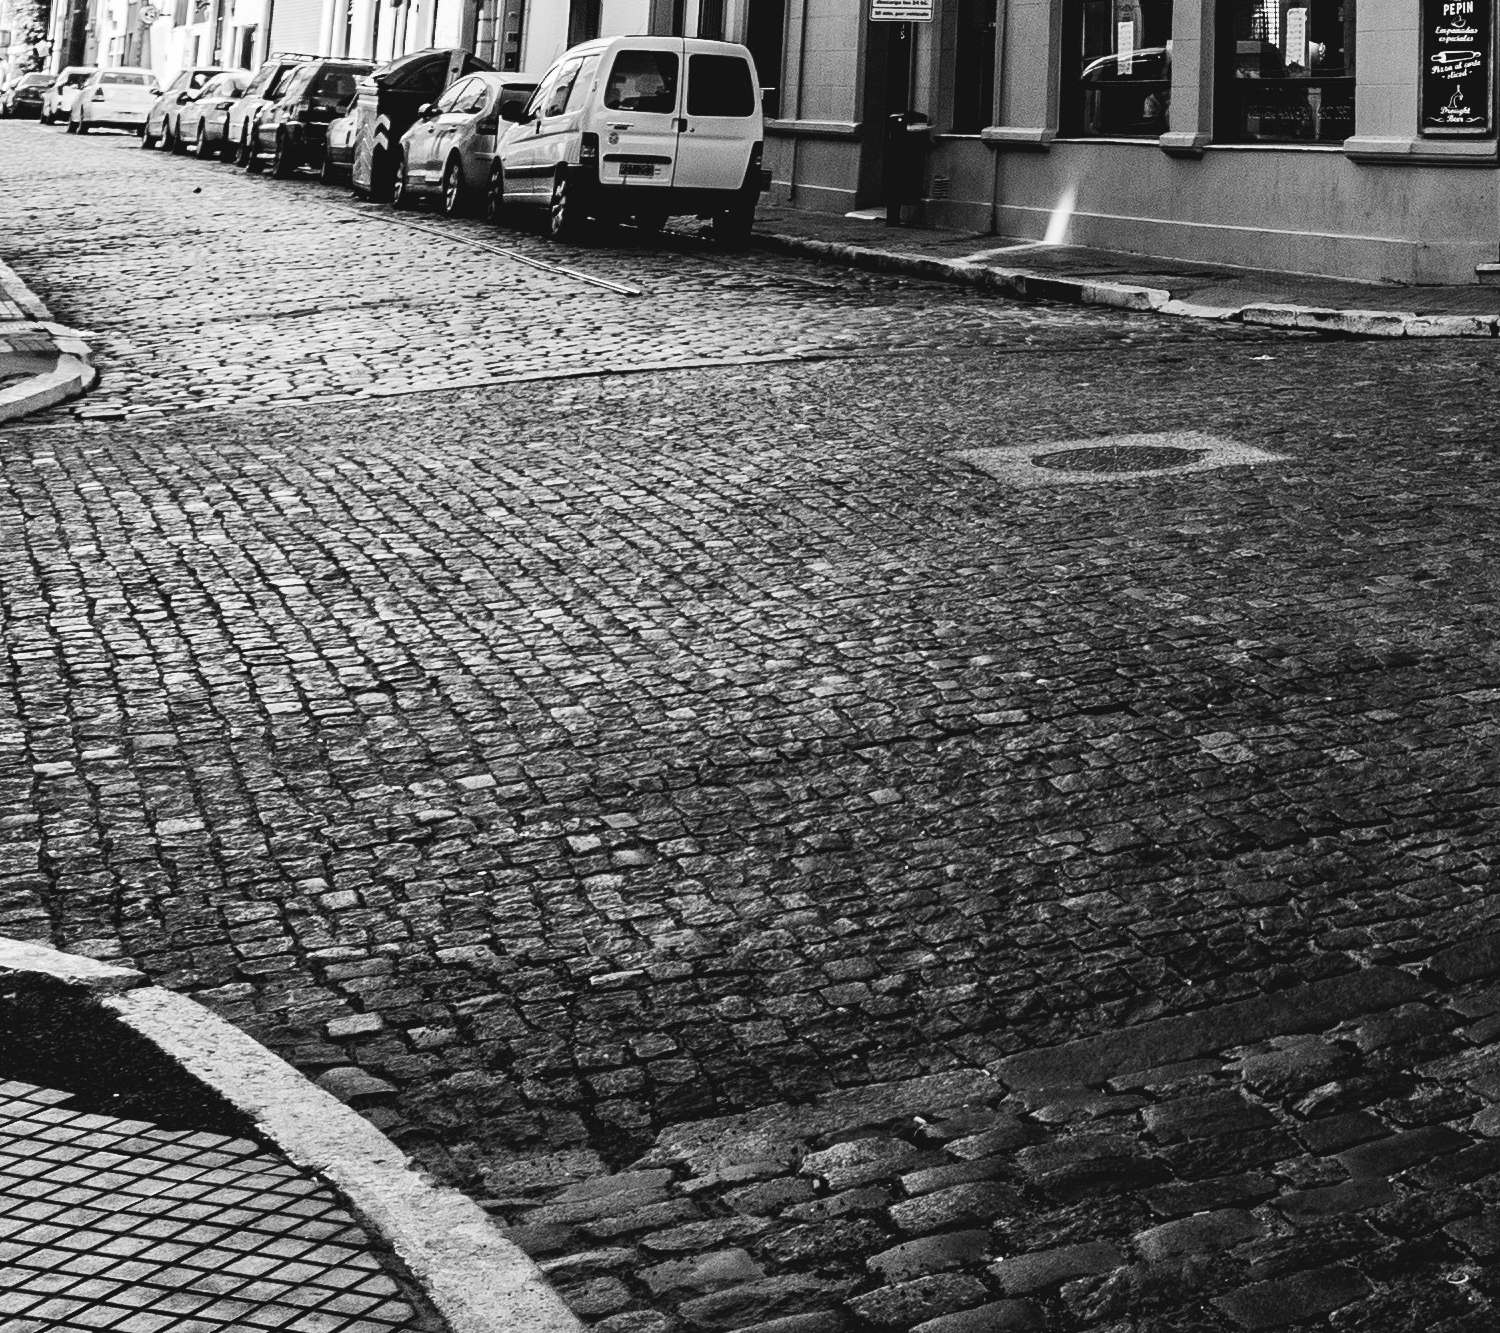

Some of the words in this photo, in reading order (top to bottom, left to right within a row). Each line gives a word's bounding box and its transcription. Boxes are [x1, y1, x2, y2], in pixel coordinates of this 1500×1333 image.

[1443, 1, 1474, 17] PEPIN
[1435, 26, 1479, 36] Empanadas
[1431, 66, 1453, 75] Pizza
